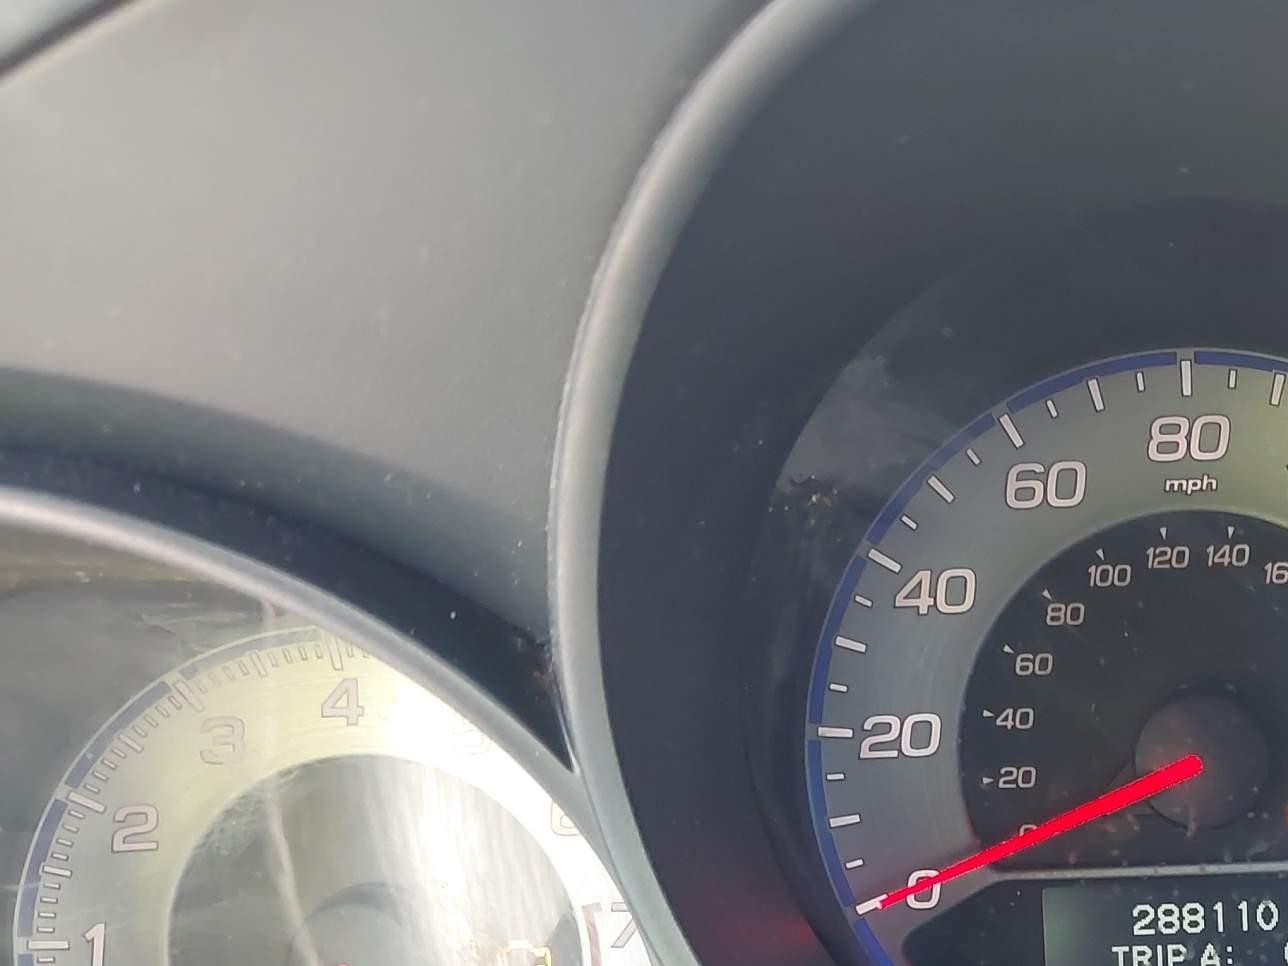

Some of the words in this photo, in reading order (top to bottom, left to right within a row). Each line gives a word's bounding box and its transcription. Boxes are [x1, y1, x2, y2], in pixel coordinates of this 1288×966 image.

[1147, 414, 1231, 463] 80
[1005, 461, 1087, 510] 60
[1164, 474, 1217, 496] mph
[1146, 545, 1190, 569] 120
[1206, 543, 1250, 567] 140
[894, 568, 977, 615] 40
[1088, 564, 1132, 587] 100
[1046, 602, 1085, 626] 80
[1015, 653, 1053, 676] 60
[320, 678, 364, 726] 4
[996, 708, 1034, 730] 40
[200, 716, 245, 764] 3
[858, 713, 942, 760] 20
[998, 766, 1037, 789] 20
[111, 803, 159, 853] 2
[906, 869, 942, 910] 0
[1132, 901, 1280, 936] 288110
